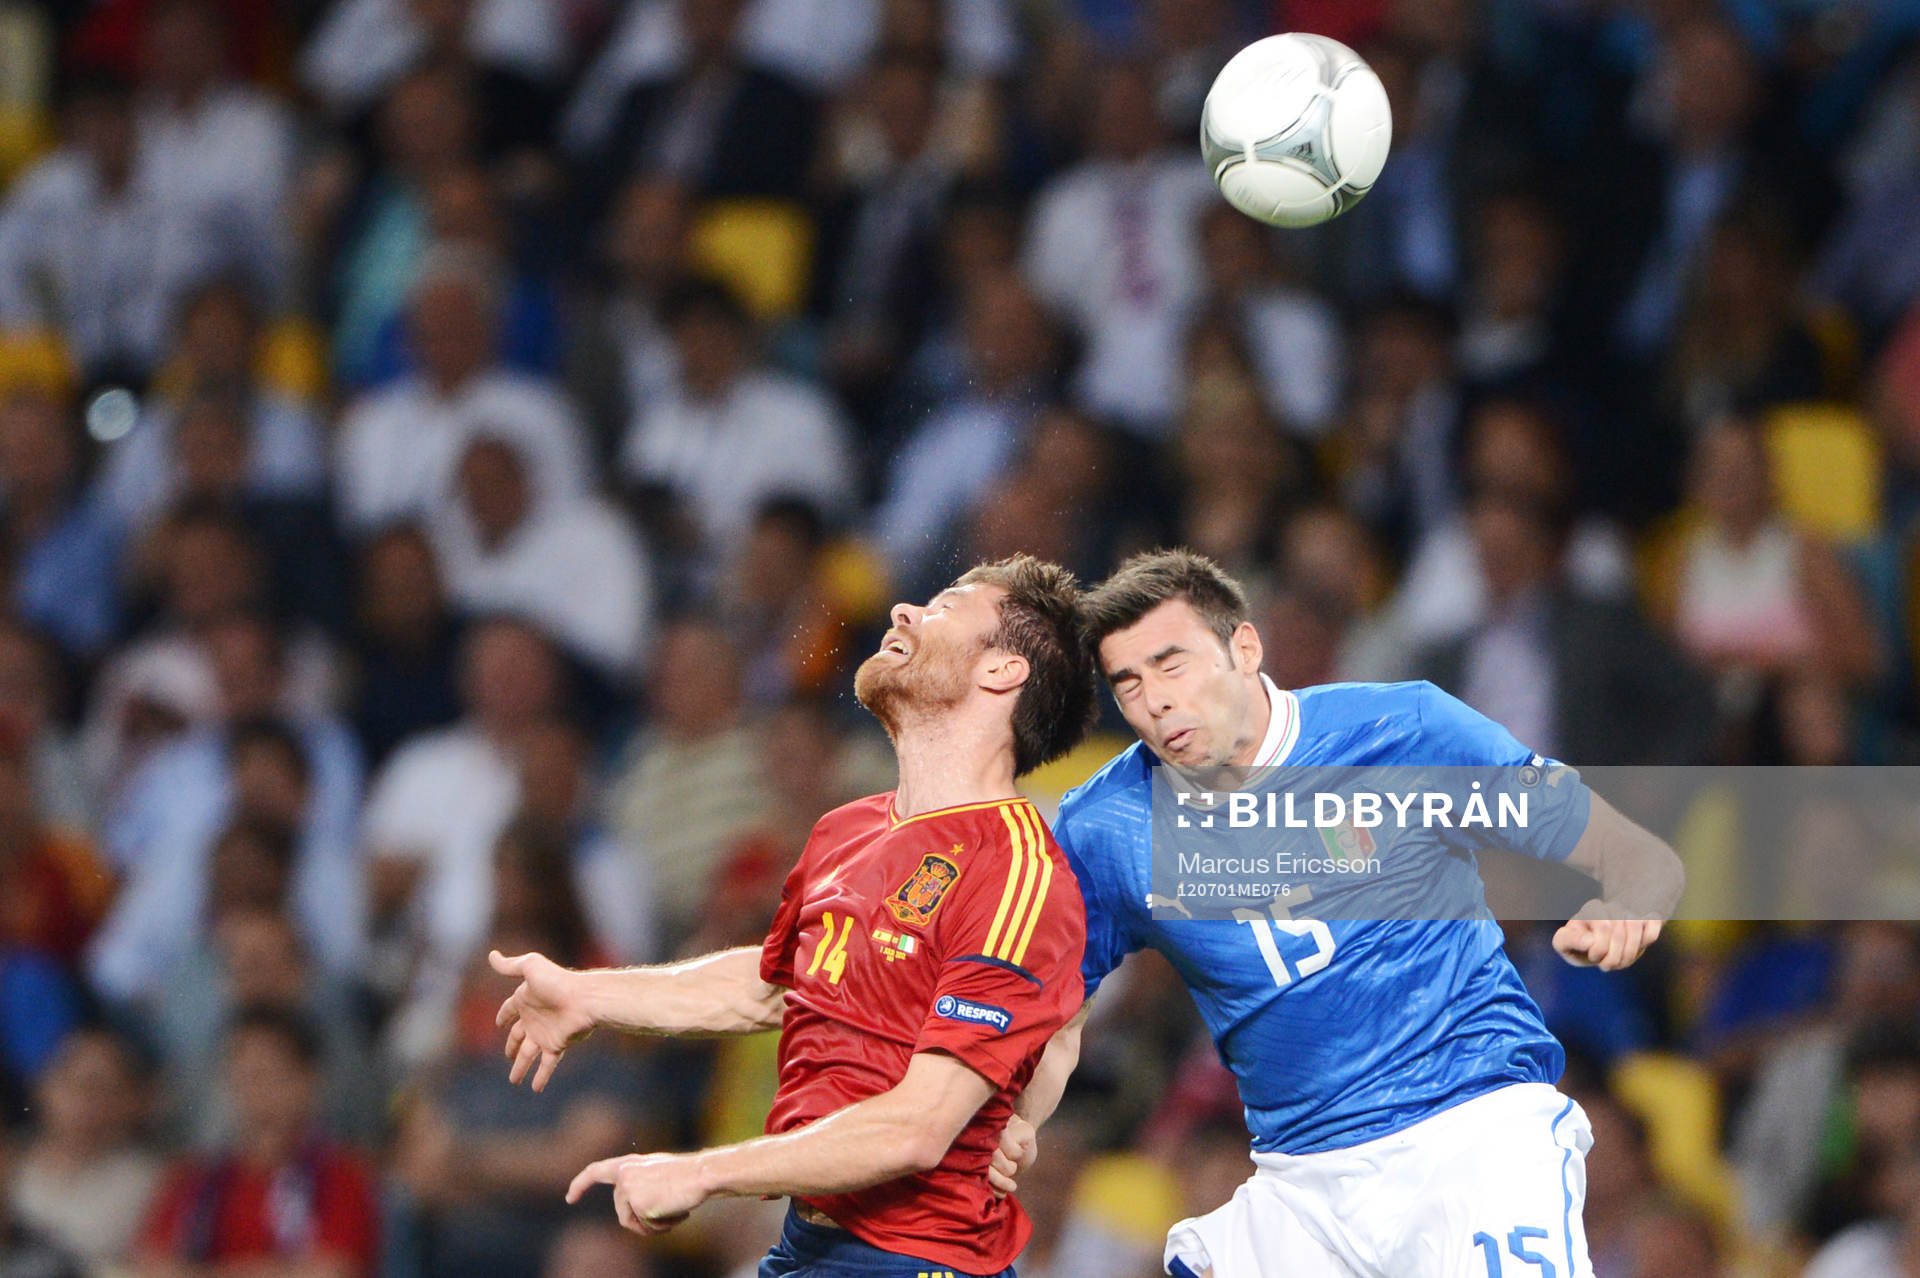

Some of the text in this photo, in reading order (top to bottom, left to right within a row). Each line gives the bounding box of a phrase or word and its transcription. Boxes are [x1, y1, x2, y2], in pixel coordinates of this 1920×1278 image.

[806, 911, 855, 985] 14
[1231, 884, 1337, 988] 15
[957, 1004, 1009, 1028] RESPECT
[1473, 1226, 1557, 1278] 15
